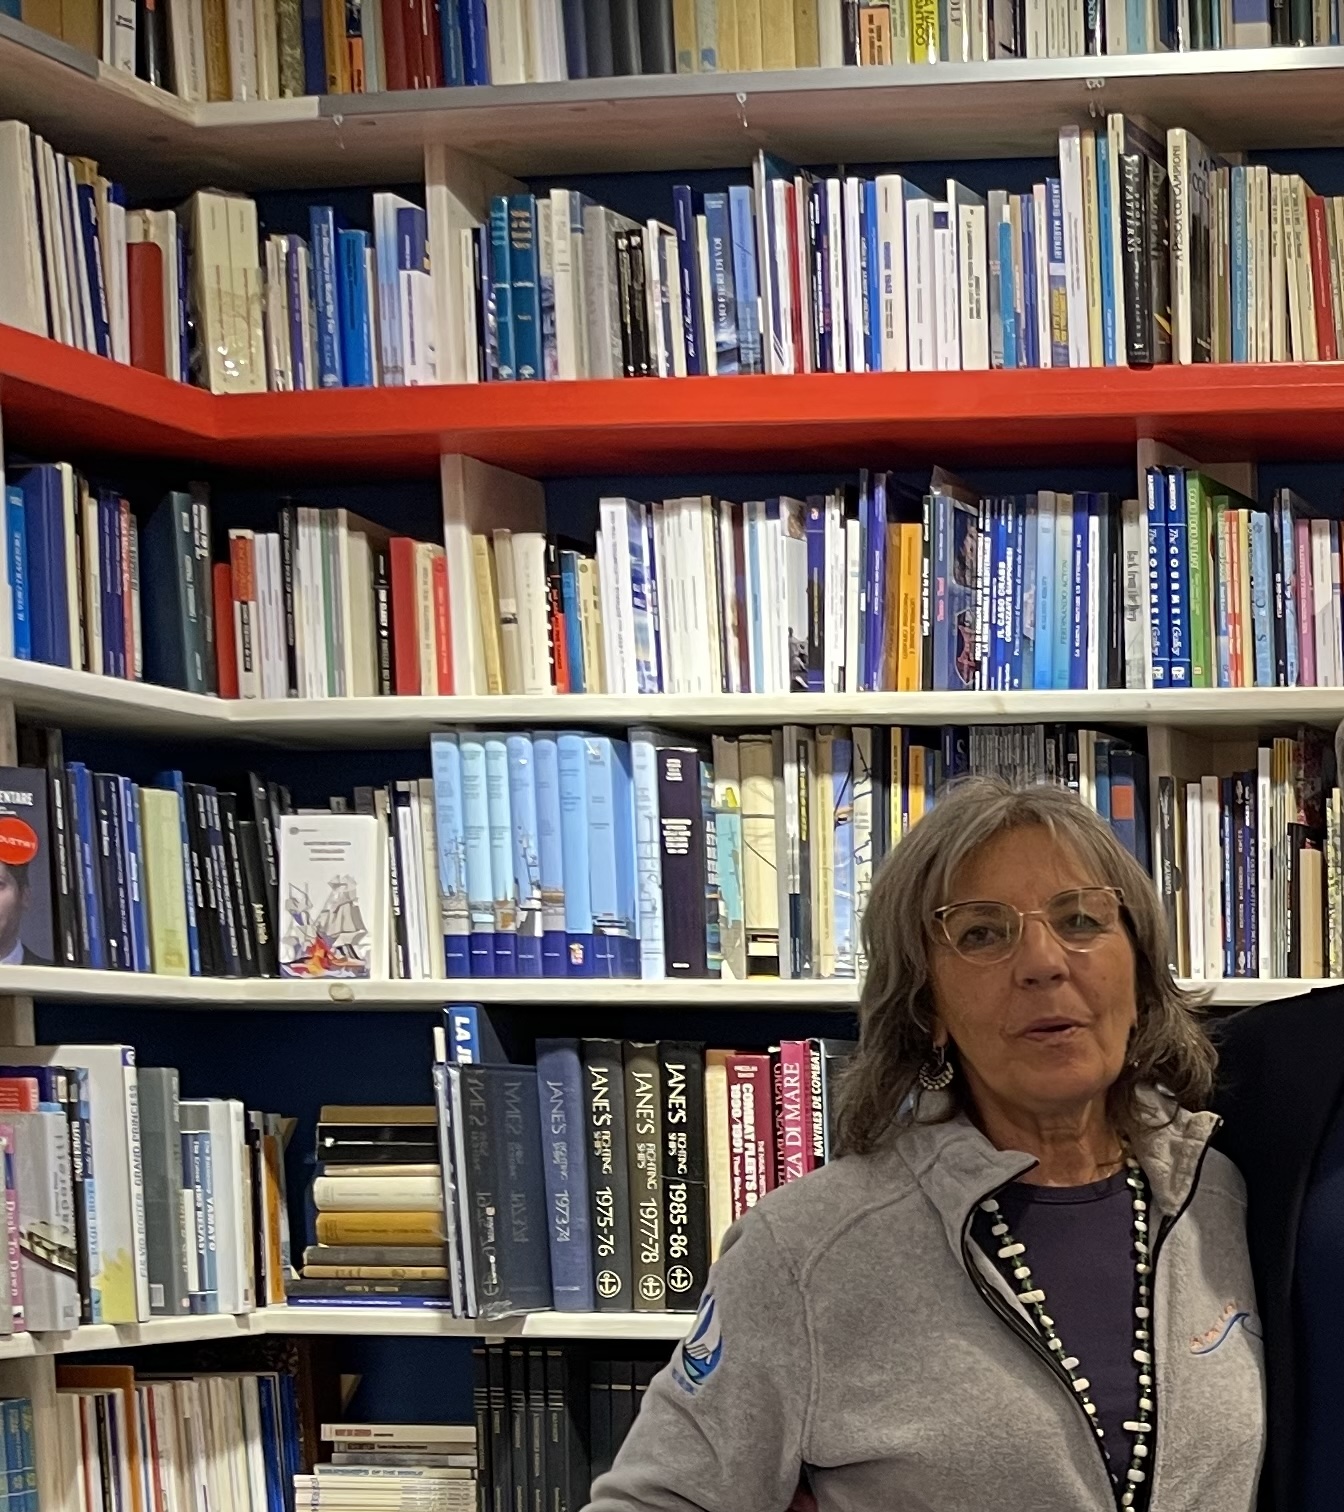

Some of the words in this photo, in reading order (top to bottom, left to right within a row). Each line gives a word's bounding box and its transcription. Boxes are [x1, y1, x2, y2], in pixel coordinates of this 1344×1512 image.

[810, 1050, 824, 1091] COMBAT
[589, 1065, 613, 1126] JANE'S
[632, 1071, 655, 1135] JANE'S
[665, 1062, 687, 1124] JANE'S
[812, 1093, 823, 1109] DE
[593, 1130, 602, 1156] SHIPS
[601, 1130, 612, 1174] FIGHTING
[636, 1142, 647, 1169] SHIPS
[668, 1132, 677, 1157] SHIPS
[676, 1132, 688, 1174] FIGHTING
[812, 1112, 824, 1157] NAVIRES
[646, 1142, 657, 1189] FIGHTING
[4, 1200, 18, 1233] Dusk
[596, 1186, 614, 1257] 1975-76
[638, 1196, 659, 1264] 1977-78
[669, 1182, 688, 1259] 1985-86
[7, 1238, 18, 1256] To
[9, 1260, 20, 1297] Dawn
